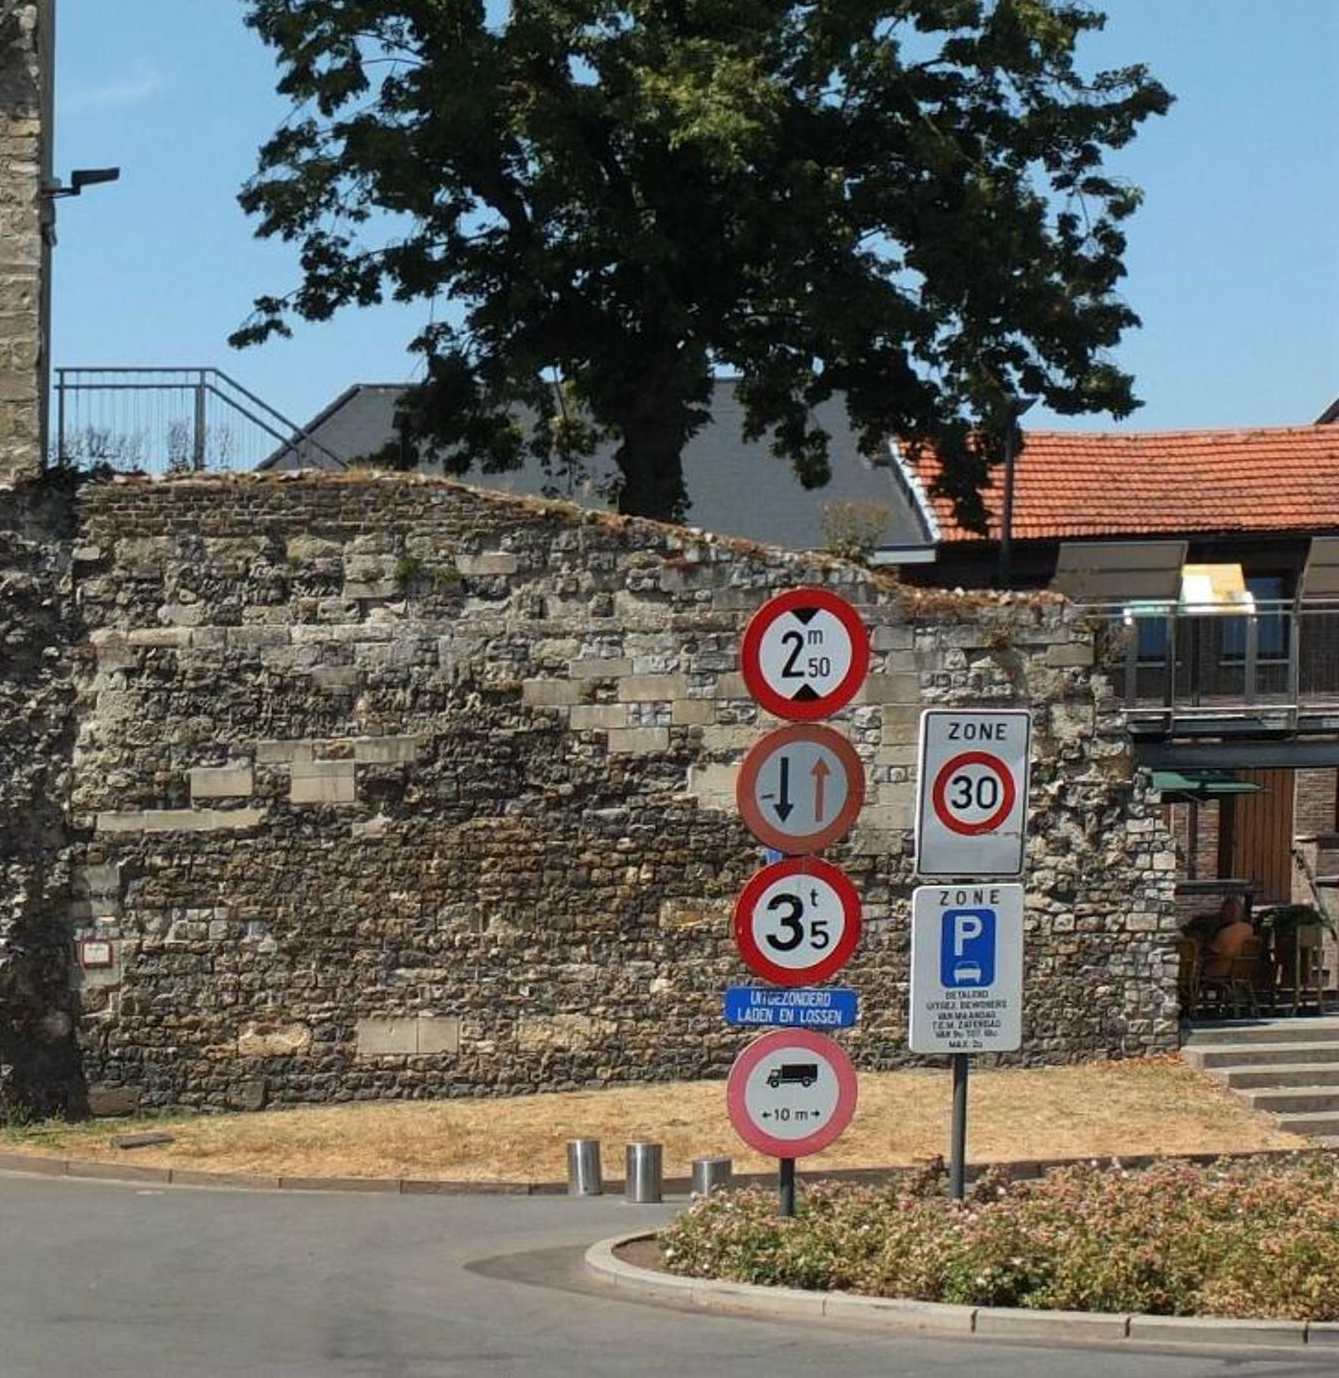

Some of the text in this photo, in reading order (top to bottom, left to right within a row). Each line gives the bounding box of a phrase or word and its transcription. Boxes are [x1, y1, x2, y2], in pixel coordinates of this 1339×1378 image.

[781, 629, 831, 679] 2 m 50
[948, 723, 1008, 741] ZONE
[950, 775, 998, 810] 30
[939, 889, 1000, 905] ZONE
[766, 893, 804, 952] 3
[810, 920, 829, 950] 5
[750, 990, 831, 1007] UITGEZONDERD
[737, 1007, 842, 1025] LADEN EN LOSSEN
[774, 1108, 809, 1121] 10 m
